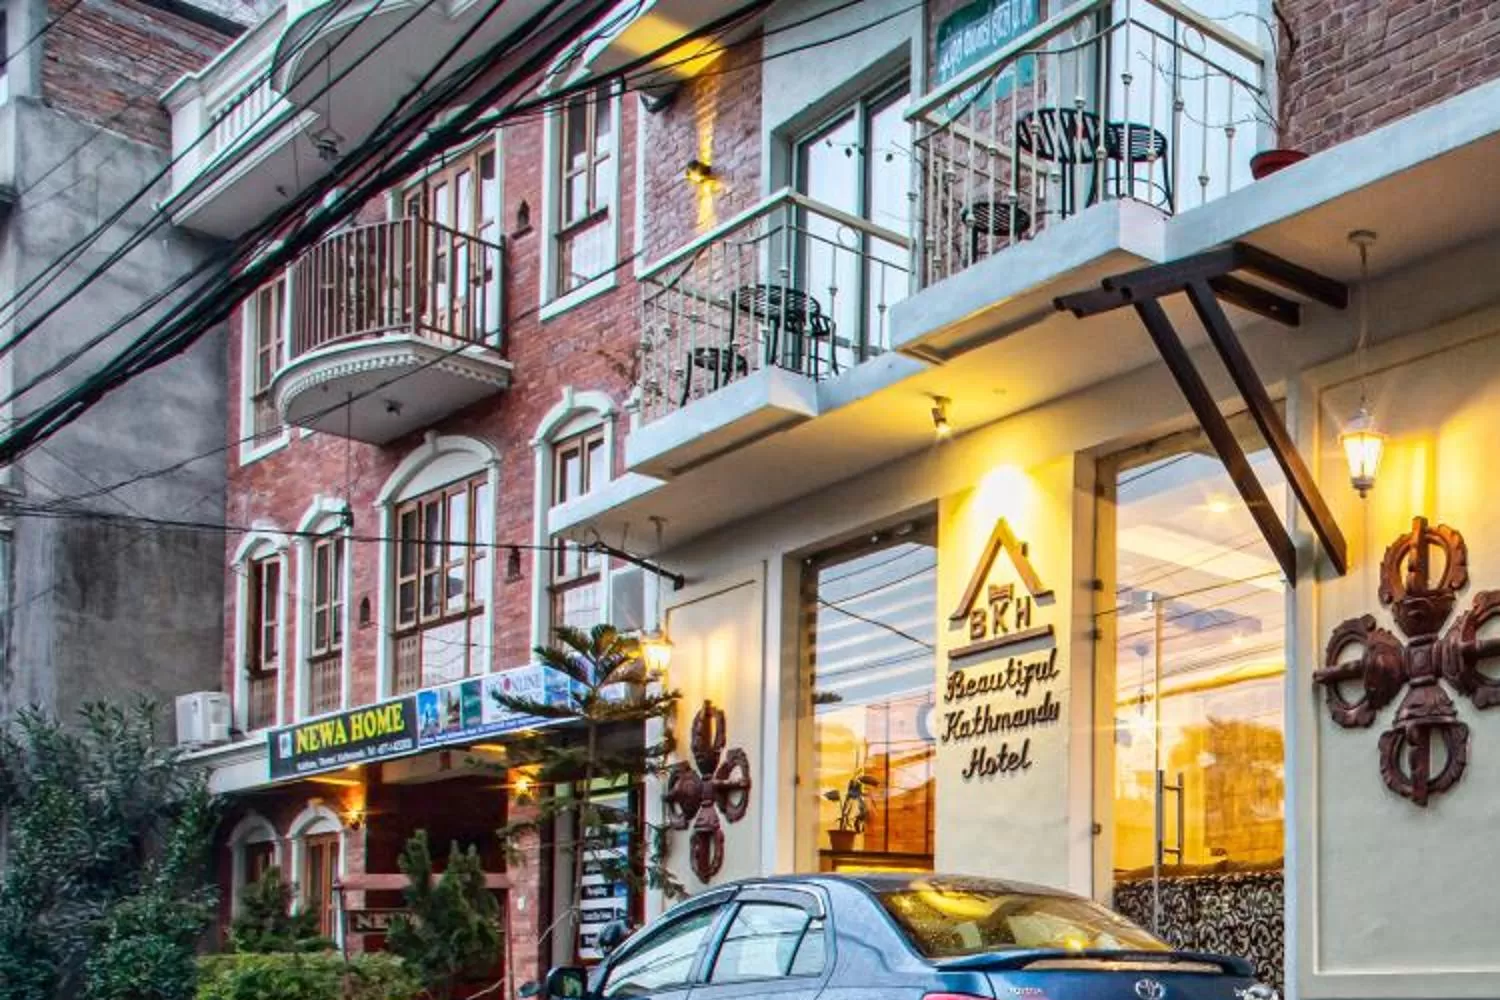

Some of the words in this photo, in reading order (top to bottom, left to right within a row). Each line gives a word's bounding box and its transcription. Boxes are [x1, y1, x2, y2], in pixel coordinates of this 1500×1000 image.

[970, 596, 1031, 640] BKH
[944, 648, 1060, 701] Beautiful
[296, 717, 347, 754] NEWA
[350, 702, 405, 742] HOME
[942, 691, 1060, 743] Kathmandu
[961, 738, 1032, 779] Hotel
